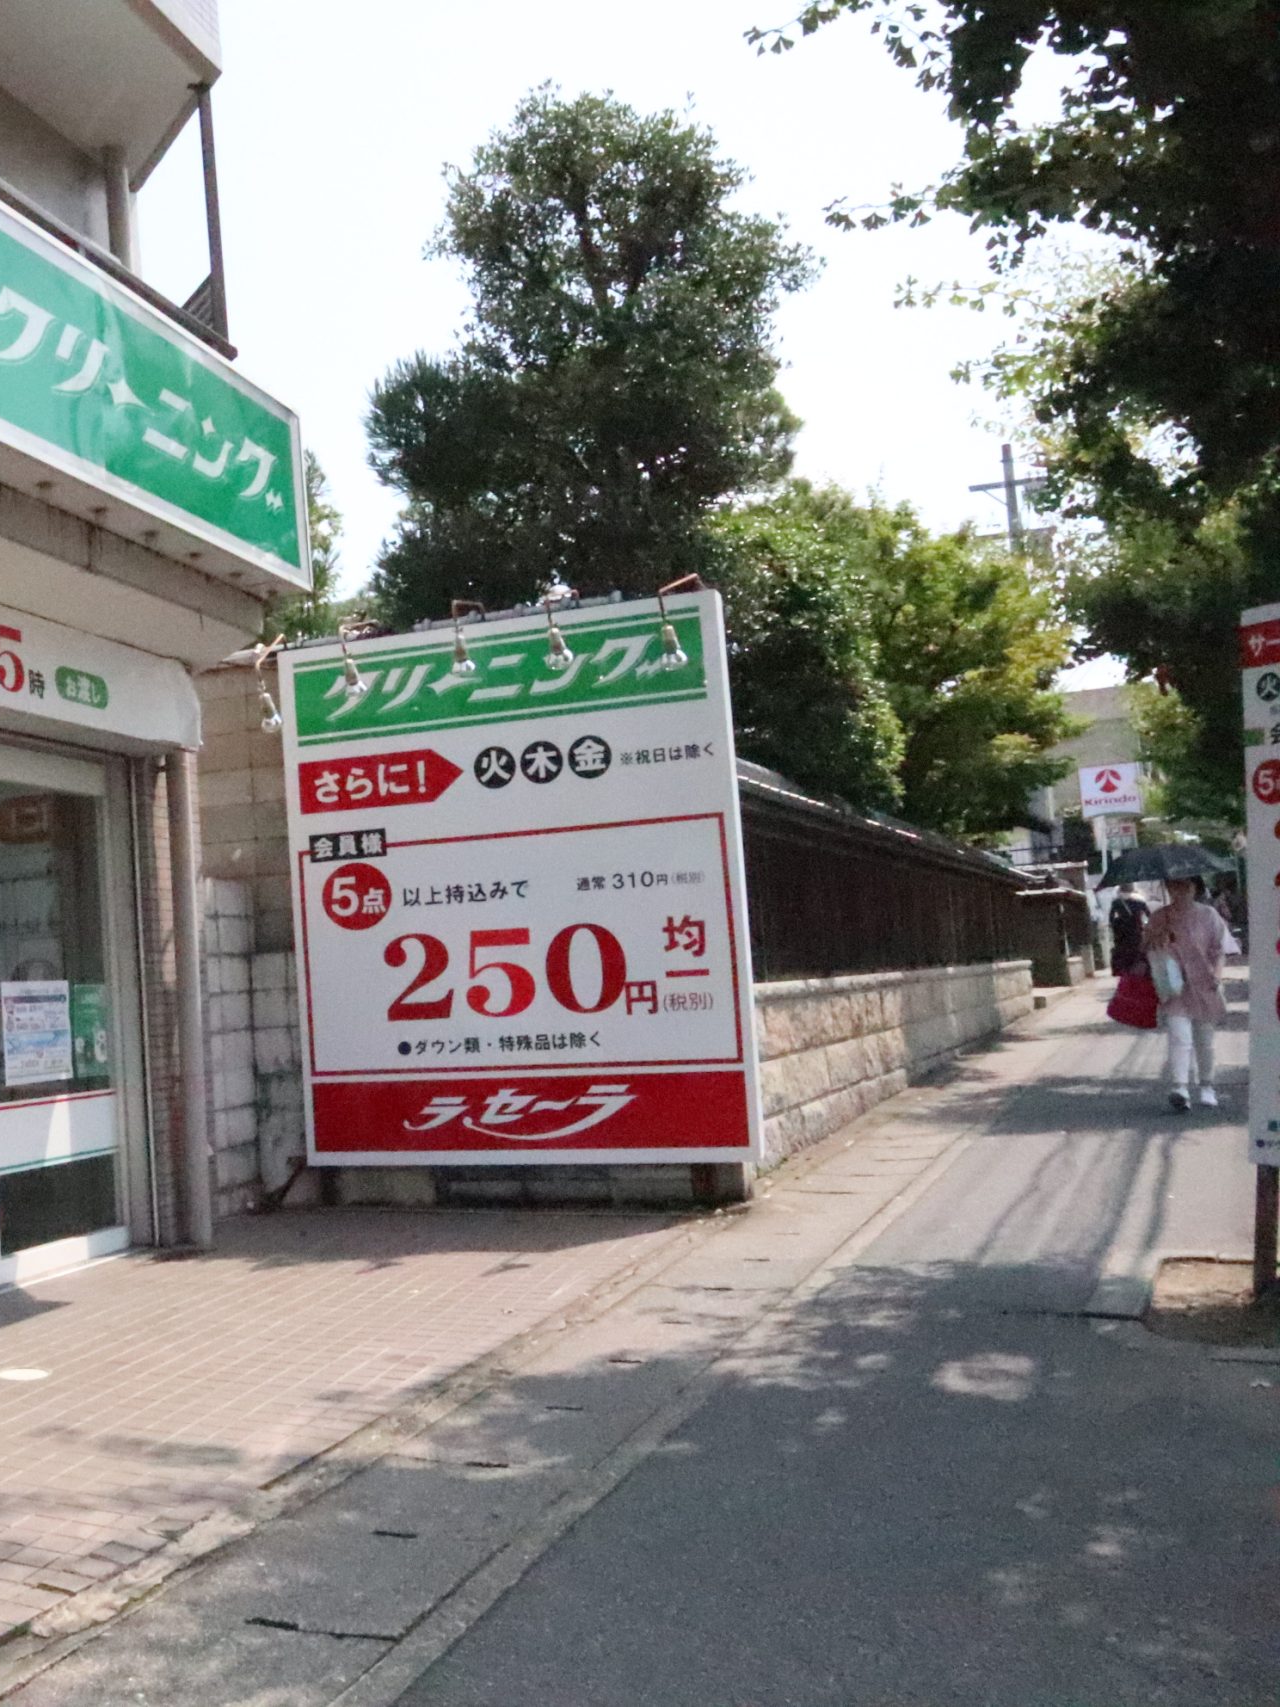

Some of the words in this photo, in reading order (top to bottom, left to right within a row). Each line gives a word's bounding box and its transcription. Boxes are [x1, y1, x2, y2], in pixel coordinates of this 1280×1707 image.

[314, 760, 426, 804] さらに!
[479, 751, 511, 783] 火
[525, 745, 558, 779] 木
[572, 739, 607, 772] 金
[313, 832, 383, 858] 会員様
[331, 876, 387, 917] 5点
[402, 879, 529, 907] 以上持込みで
[577, 876, 606, 891] 通常
[403, 1083, 640, 1141] ラセーラ
